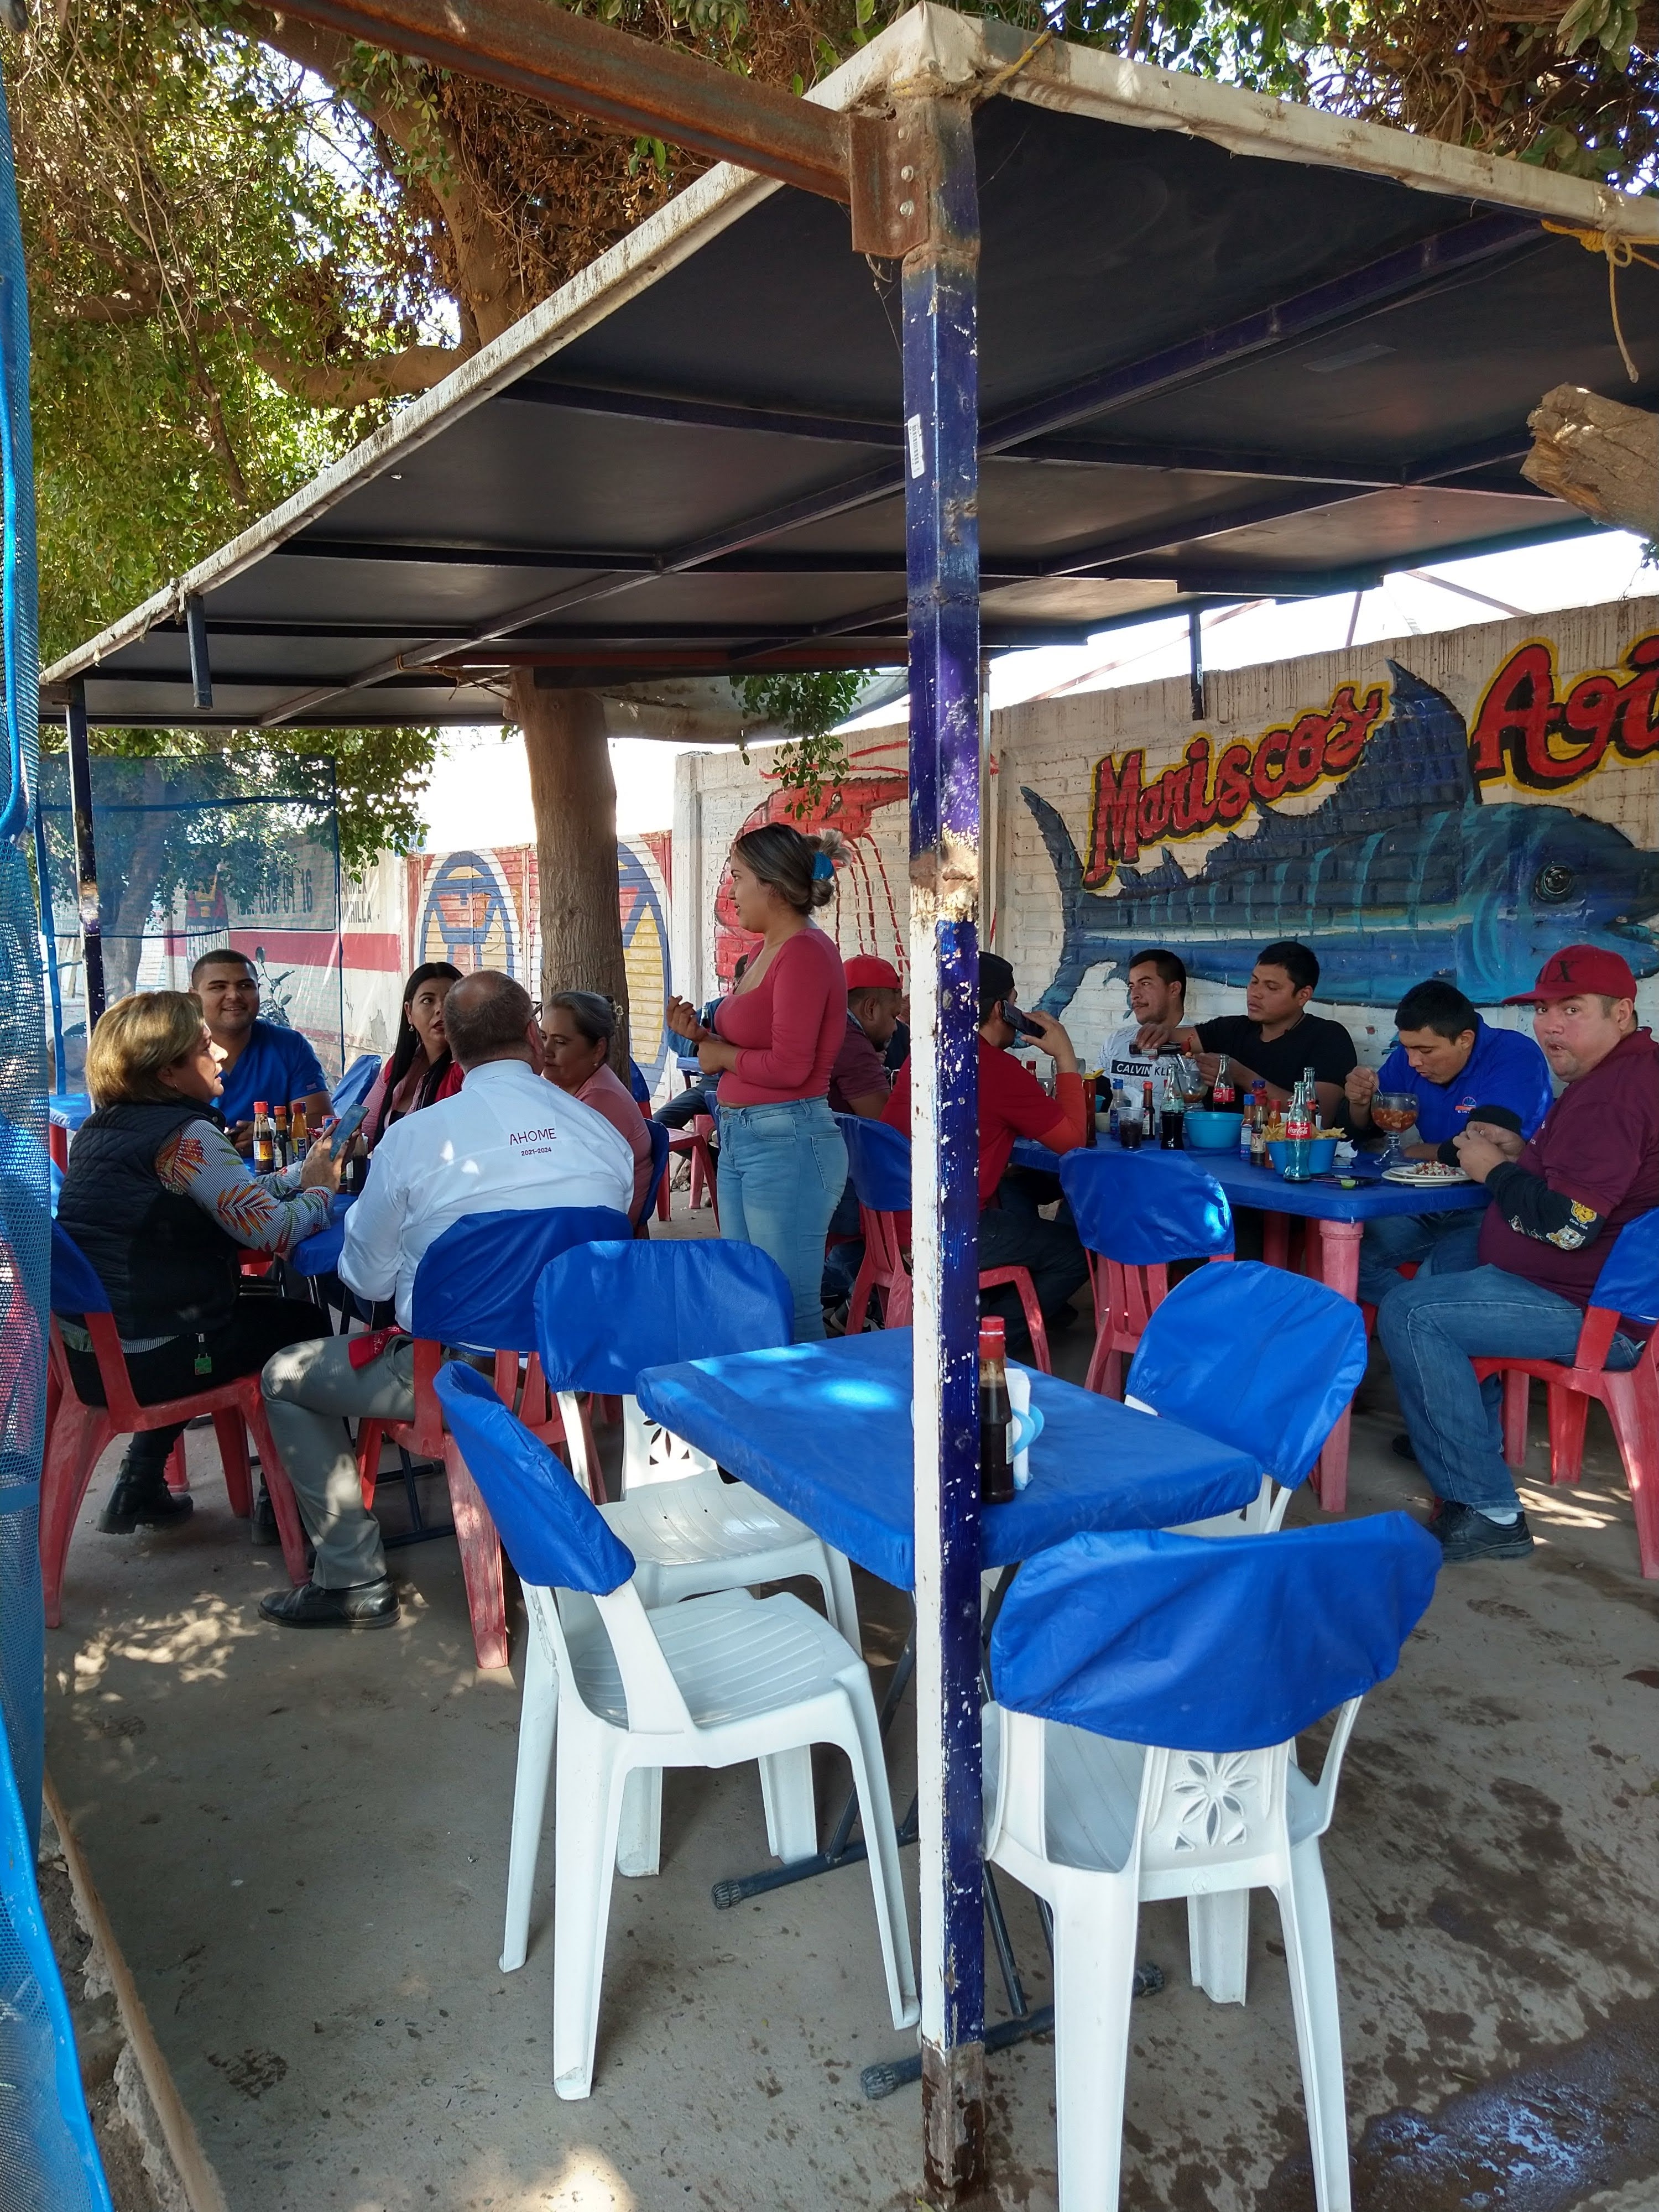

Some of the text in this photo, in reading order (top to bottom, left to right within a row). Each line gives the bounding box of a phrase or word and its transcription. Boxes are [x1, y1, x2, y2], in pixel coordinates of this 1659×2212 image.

[1083, 686, 1384, 890] Mariscos
[300, 868, 313, 913] 16
[1116, 1063, 1152, 1076] CALVIN
[509, 1128, 557, 1146] AHOME
[520, 1146, 552, 1156] 2021-2024
